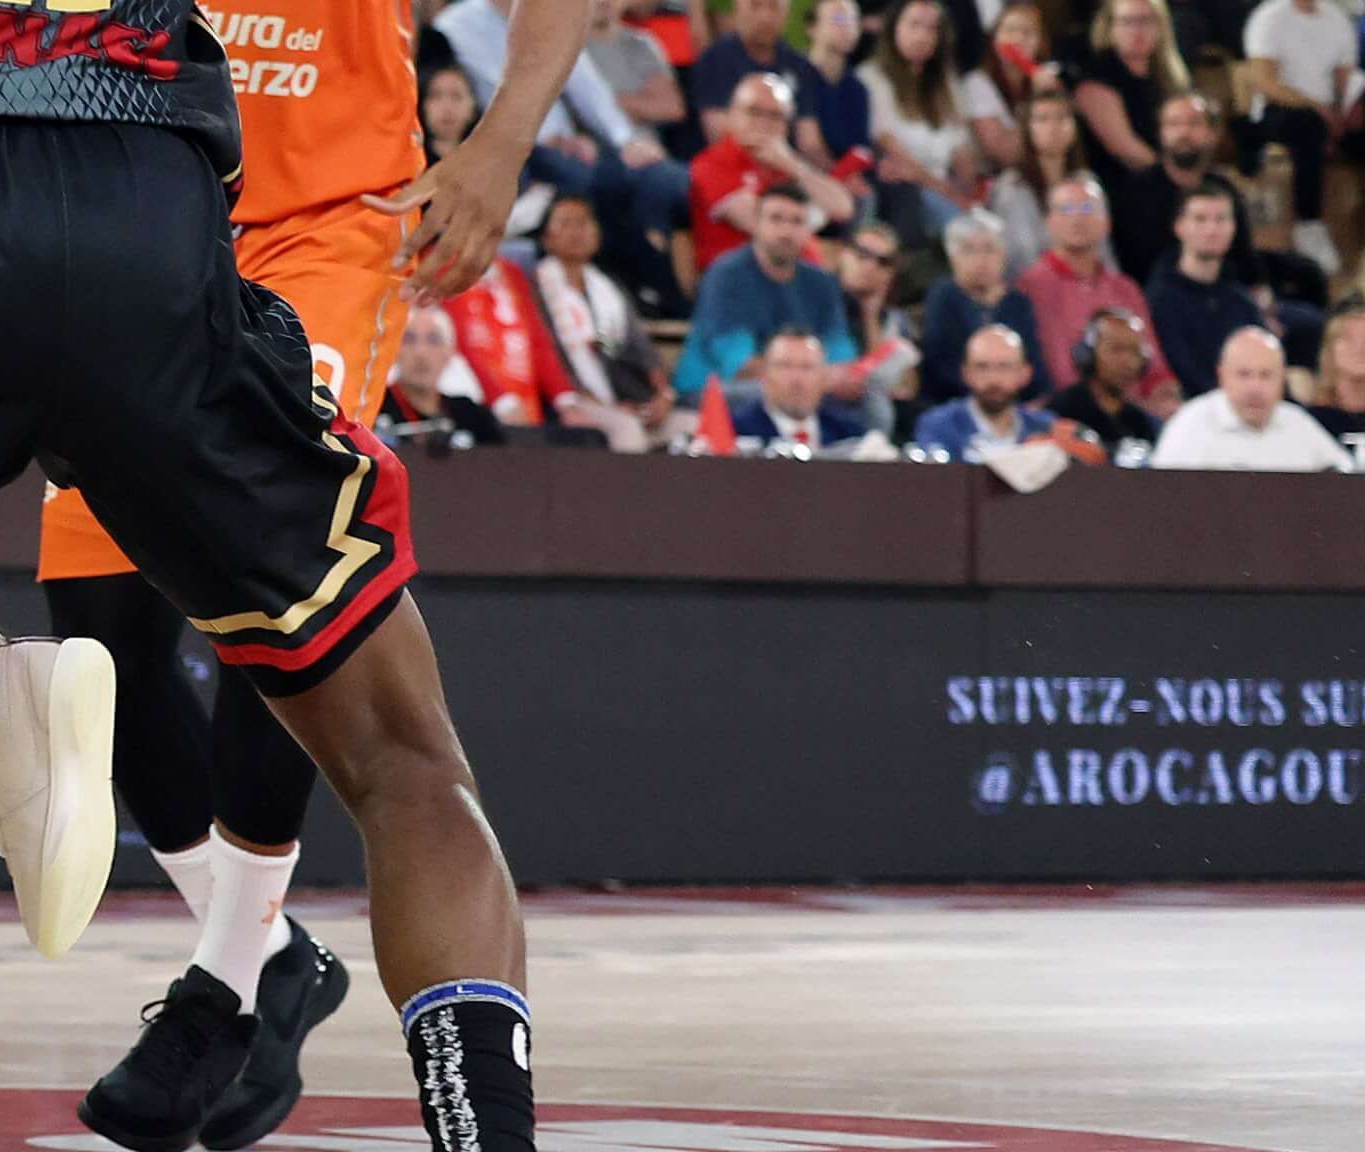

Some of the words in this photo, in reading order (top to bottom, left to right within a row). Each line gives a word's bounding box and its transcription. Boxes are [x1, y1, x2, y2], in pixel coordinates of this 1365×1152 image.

[286, 28, 323, 52] del
[946, 675, 1287, 727] SUIVEZ-NOUS
[1299, 679, 1365, 728] SU
